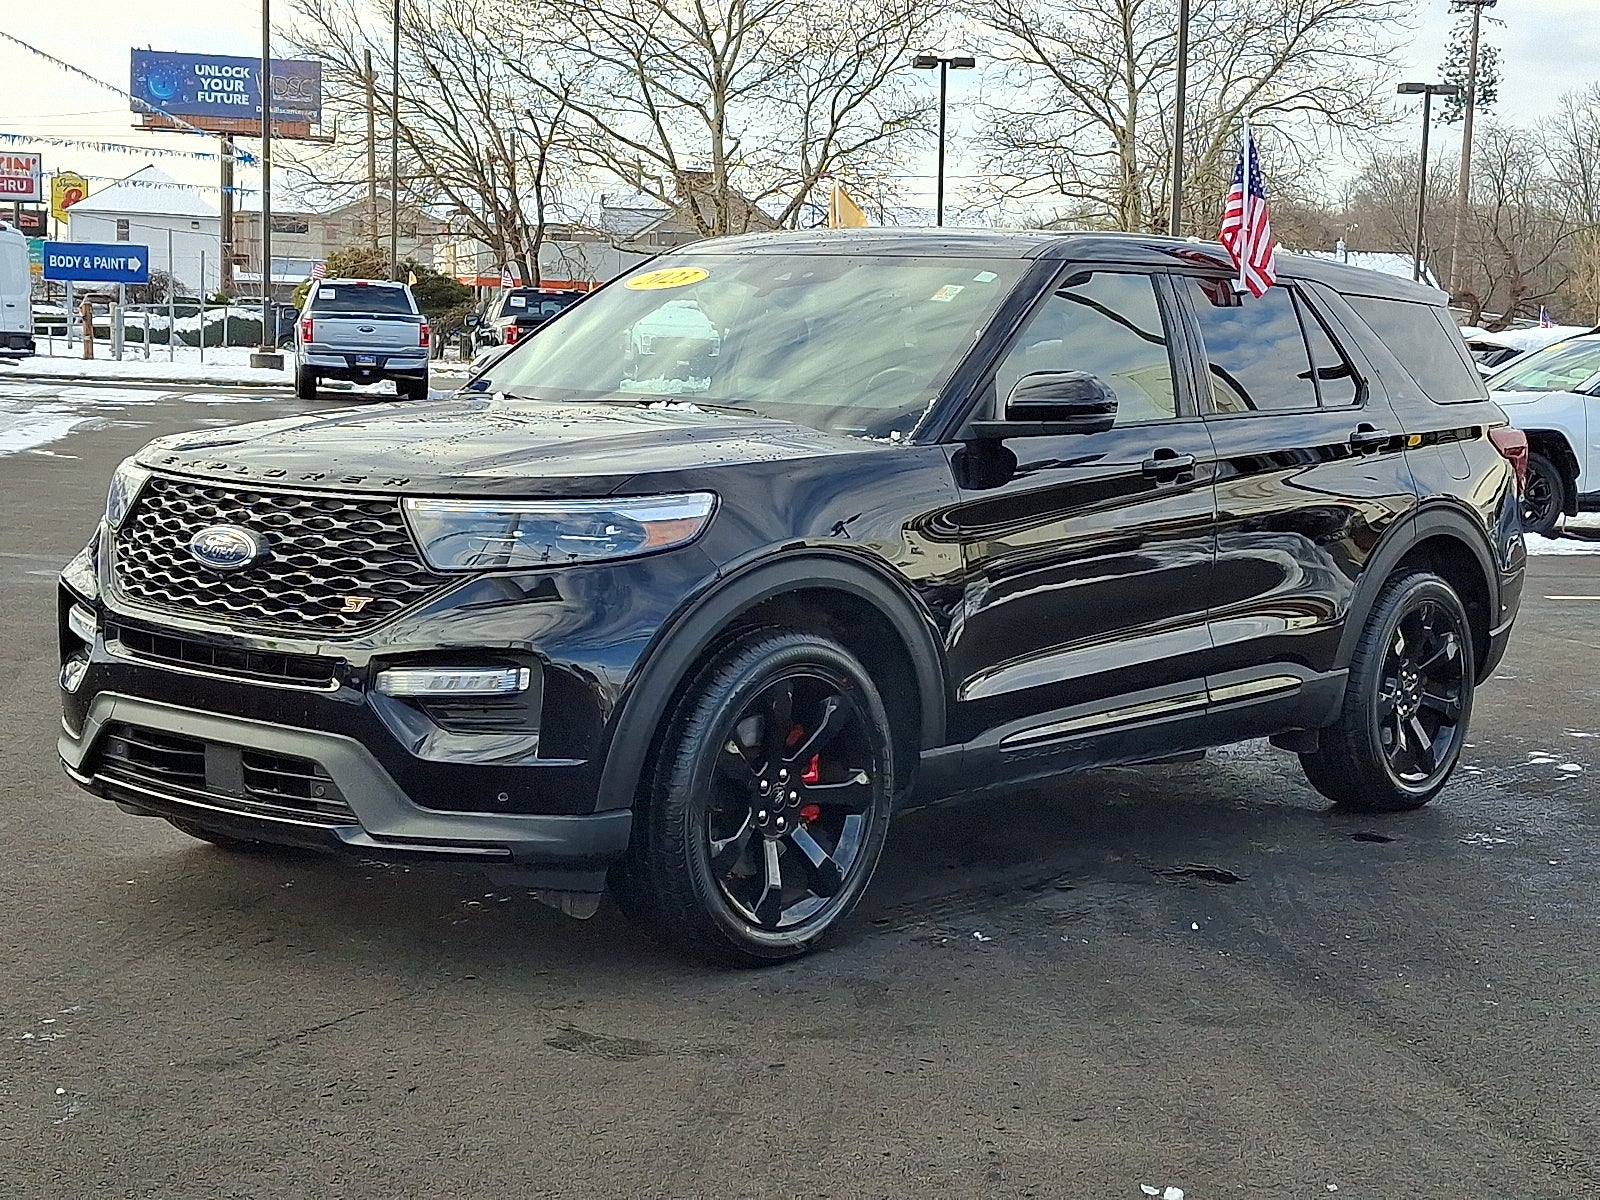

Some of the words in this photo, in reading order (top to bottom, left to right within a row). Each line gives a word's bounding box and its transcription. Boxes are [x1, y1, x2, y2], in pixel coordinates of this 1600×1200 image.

[194, 64, 250, 78] UNLOCK
[200, 77, 245, 92] YOUR
[197, 91, 250, 105] FUTURE
[49, 254, 81, 268] BODY
[83, 256, 91, 269] &
[94, 257, 126, 270] PAINT
[161, 455, 411, 487] EXPLORER
[340, 596, 374, 613] ST
